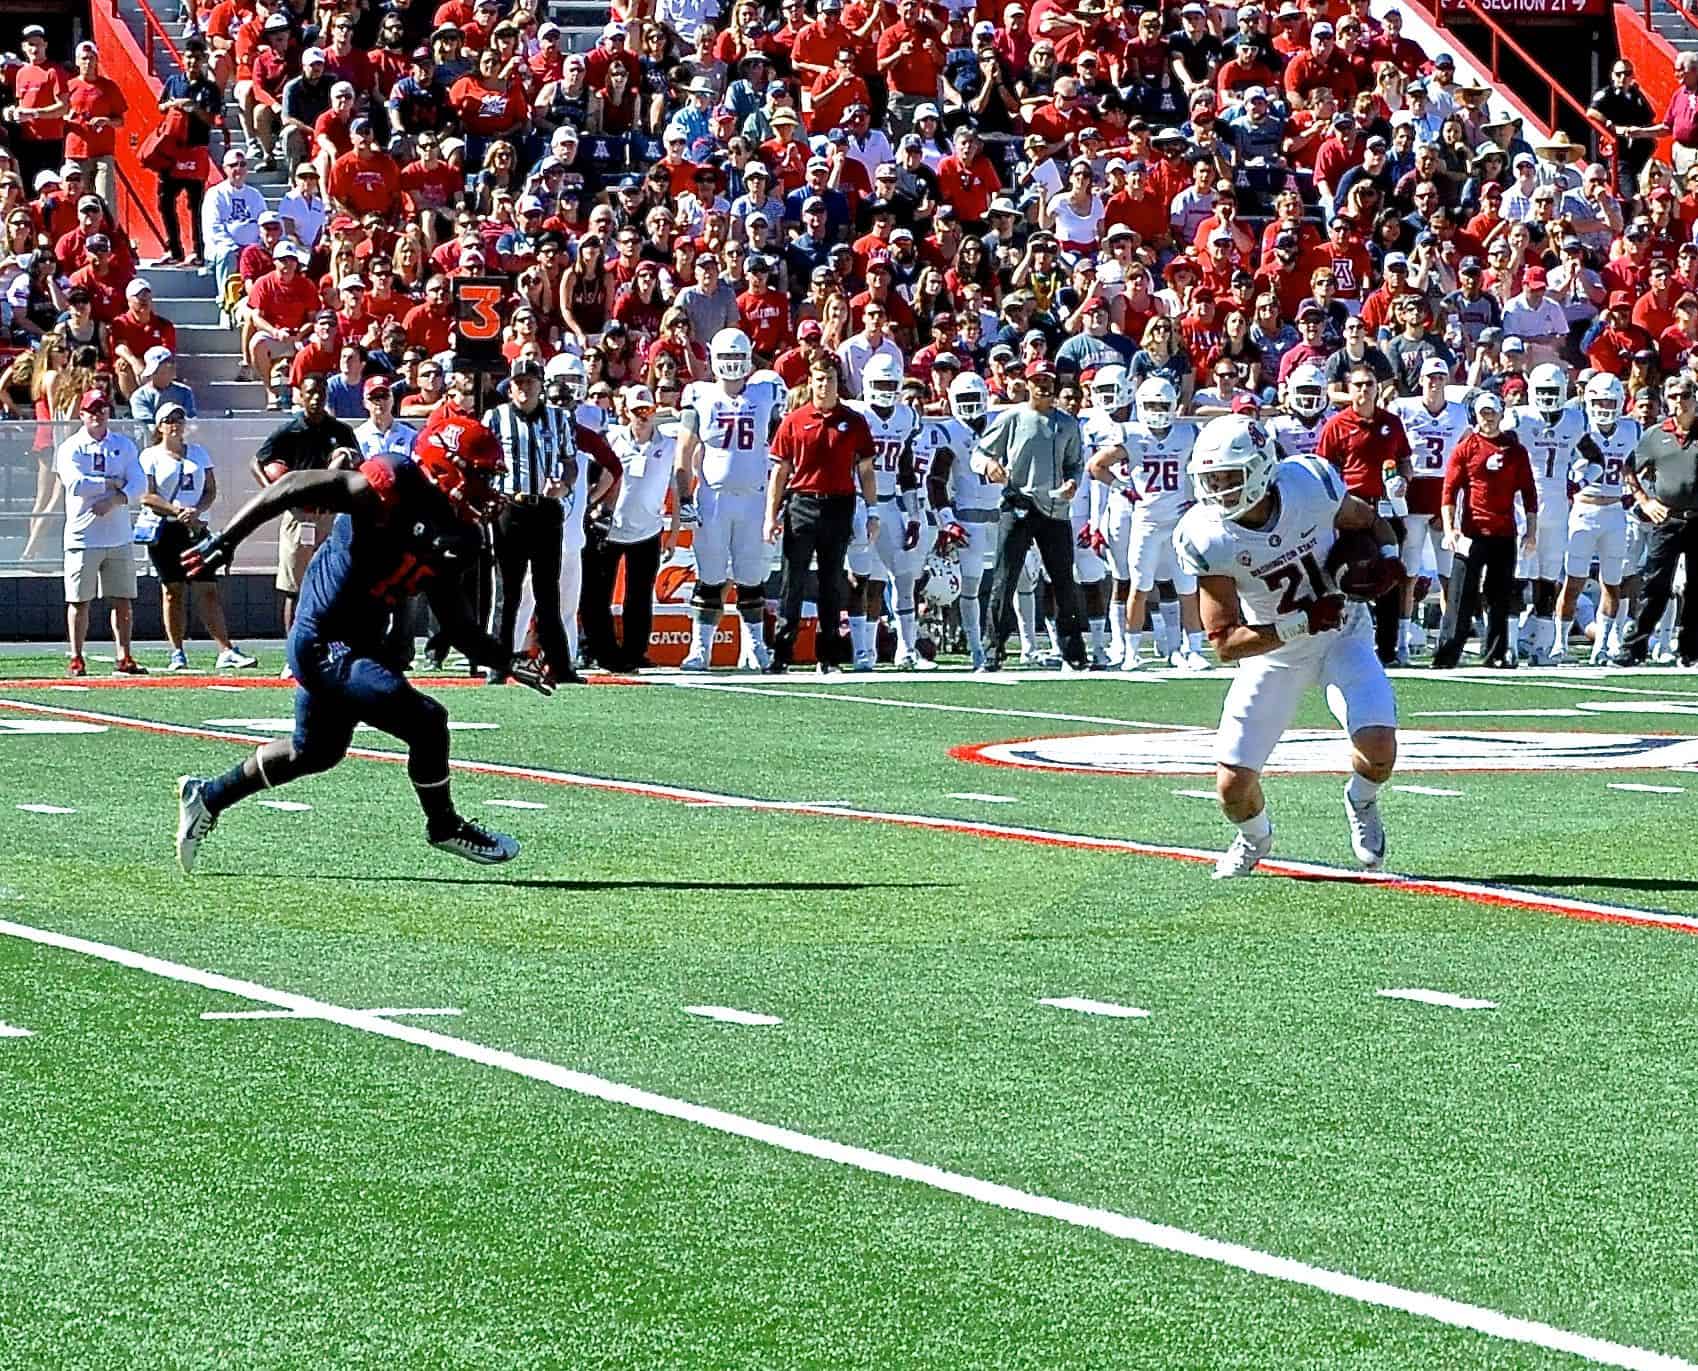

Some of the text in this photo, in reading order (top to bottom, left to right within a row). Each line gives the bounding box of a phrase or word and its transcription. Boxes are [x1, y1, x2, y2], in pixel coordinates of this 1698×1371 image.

[1481, 0, 1545, 10] SECTION
[1551, 0, 1566, 11] 21
[459, 285, 501, 339] 3
[716, 417, 755, 451] 76
[872, 441, 901, 472] 20
[1426, 437, 1445, 469] 3
[1546, 448, 1556, 478] 1
[1144, 461, 1179, 493] 26
[1258, 552, 1329, 615] 21
[650, 631, 734, 645] GATODE
